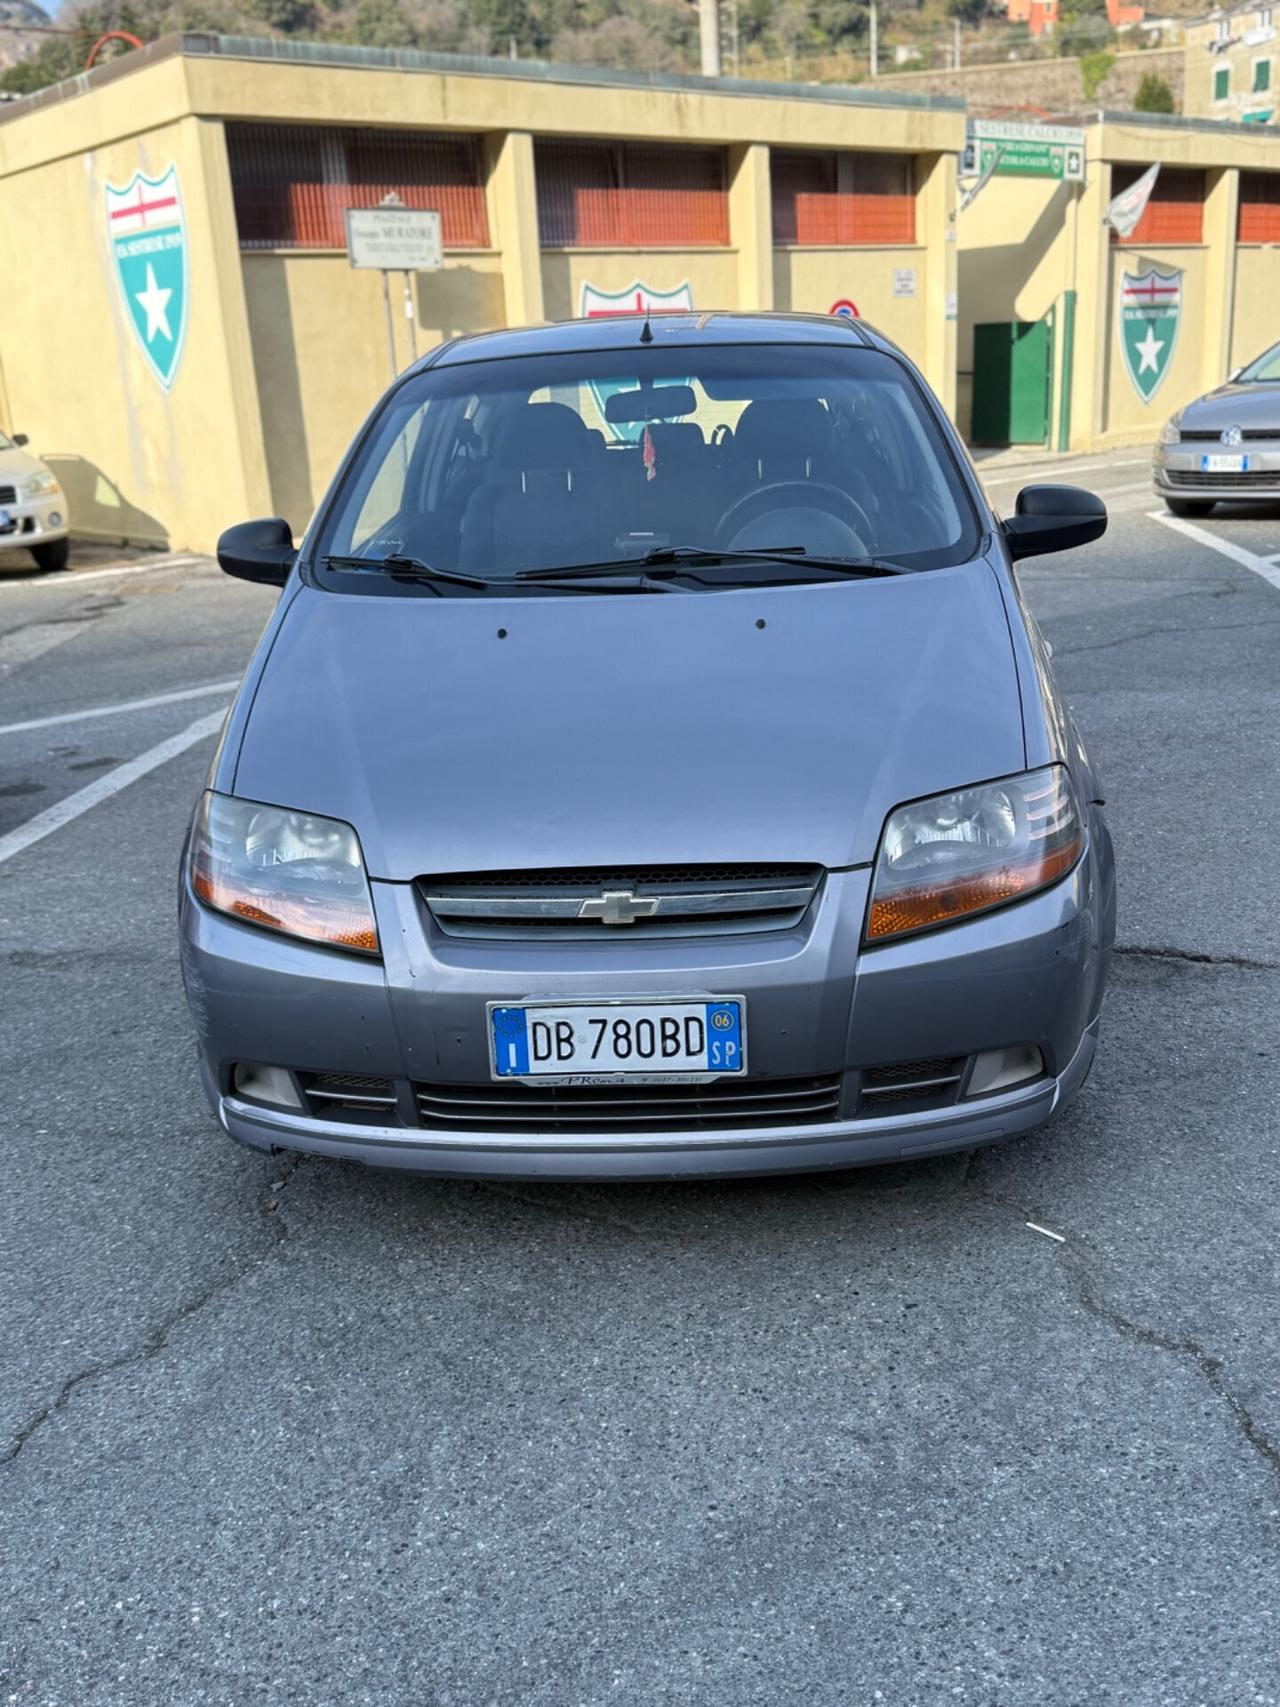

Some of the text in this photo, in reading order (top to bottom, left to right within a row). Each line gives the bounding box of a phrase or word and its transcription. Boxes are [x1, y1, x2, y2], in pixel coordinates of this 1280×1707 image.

[714, 1015, 730, 1027] 06
[532, 1016, 705, 1062] DB 780BD
[711, 1041, 736, 1068] SP
